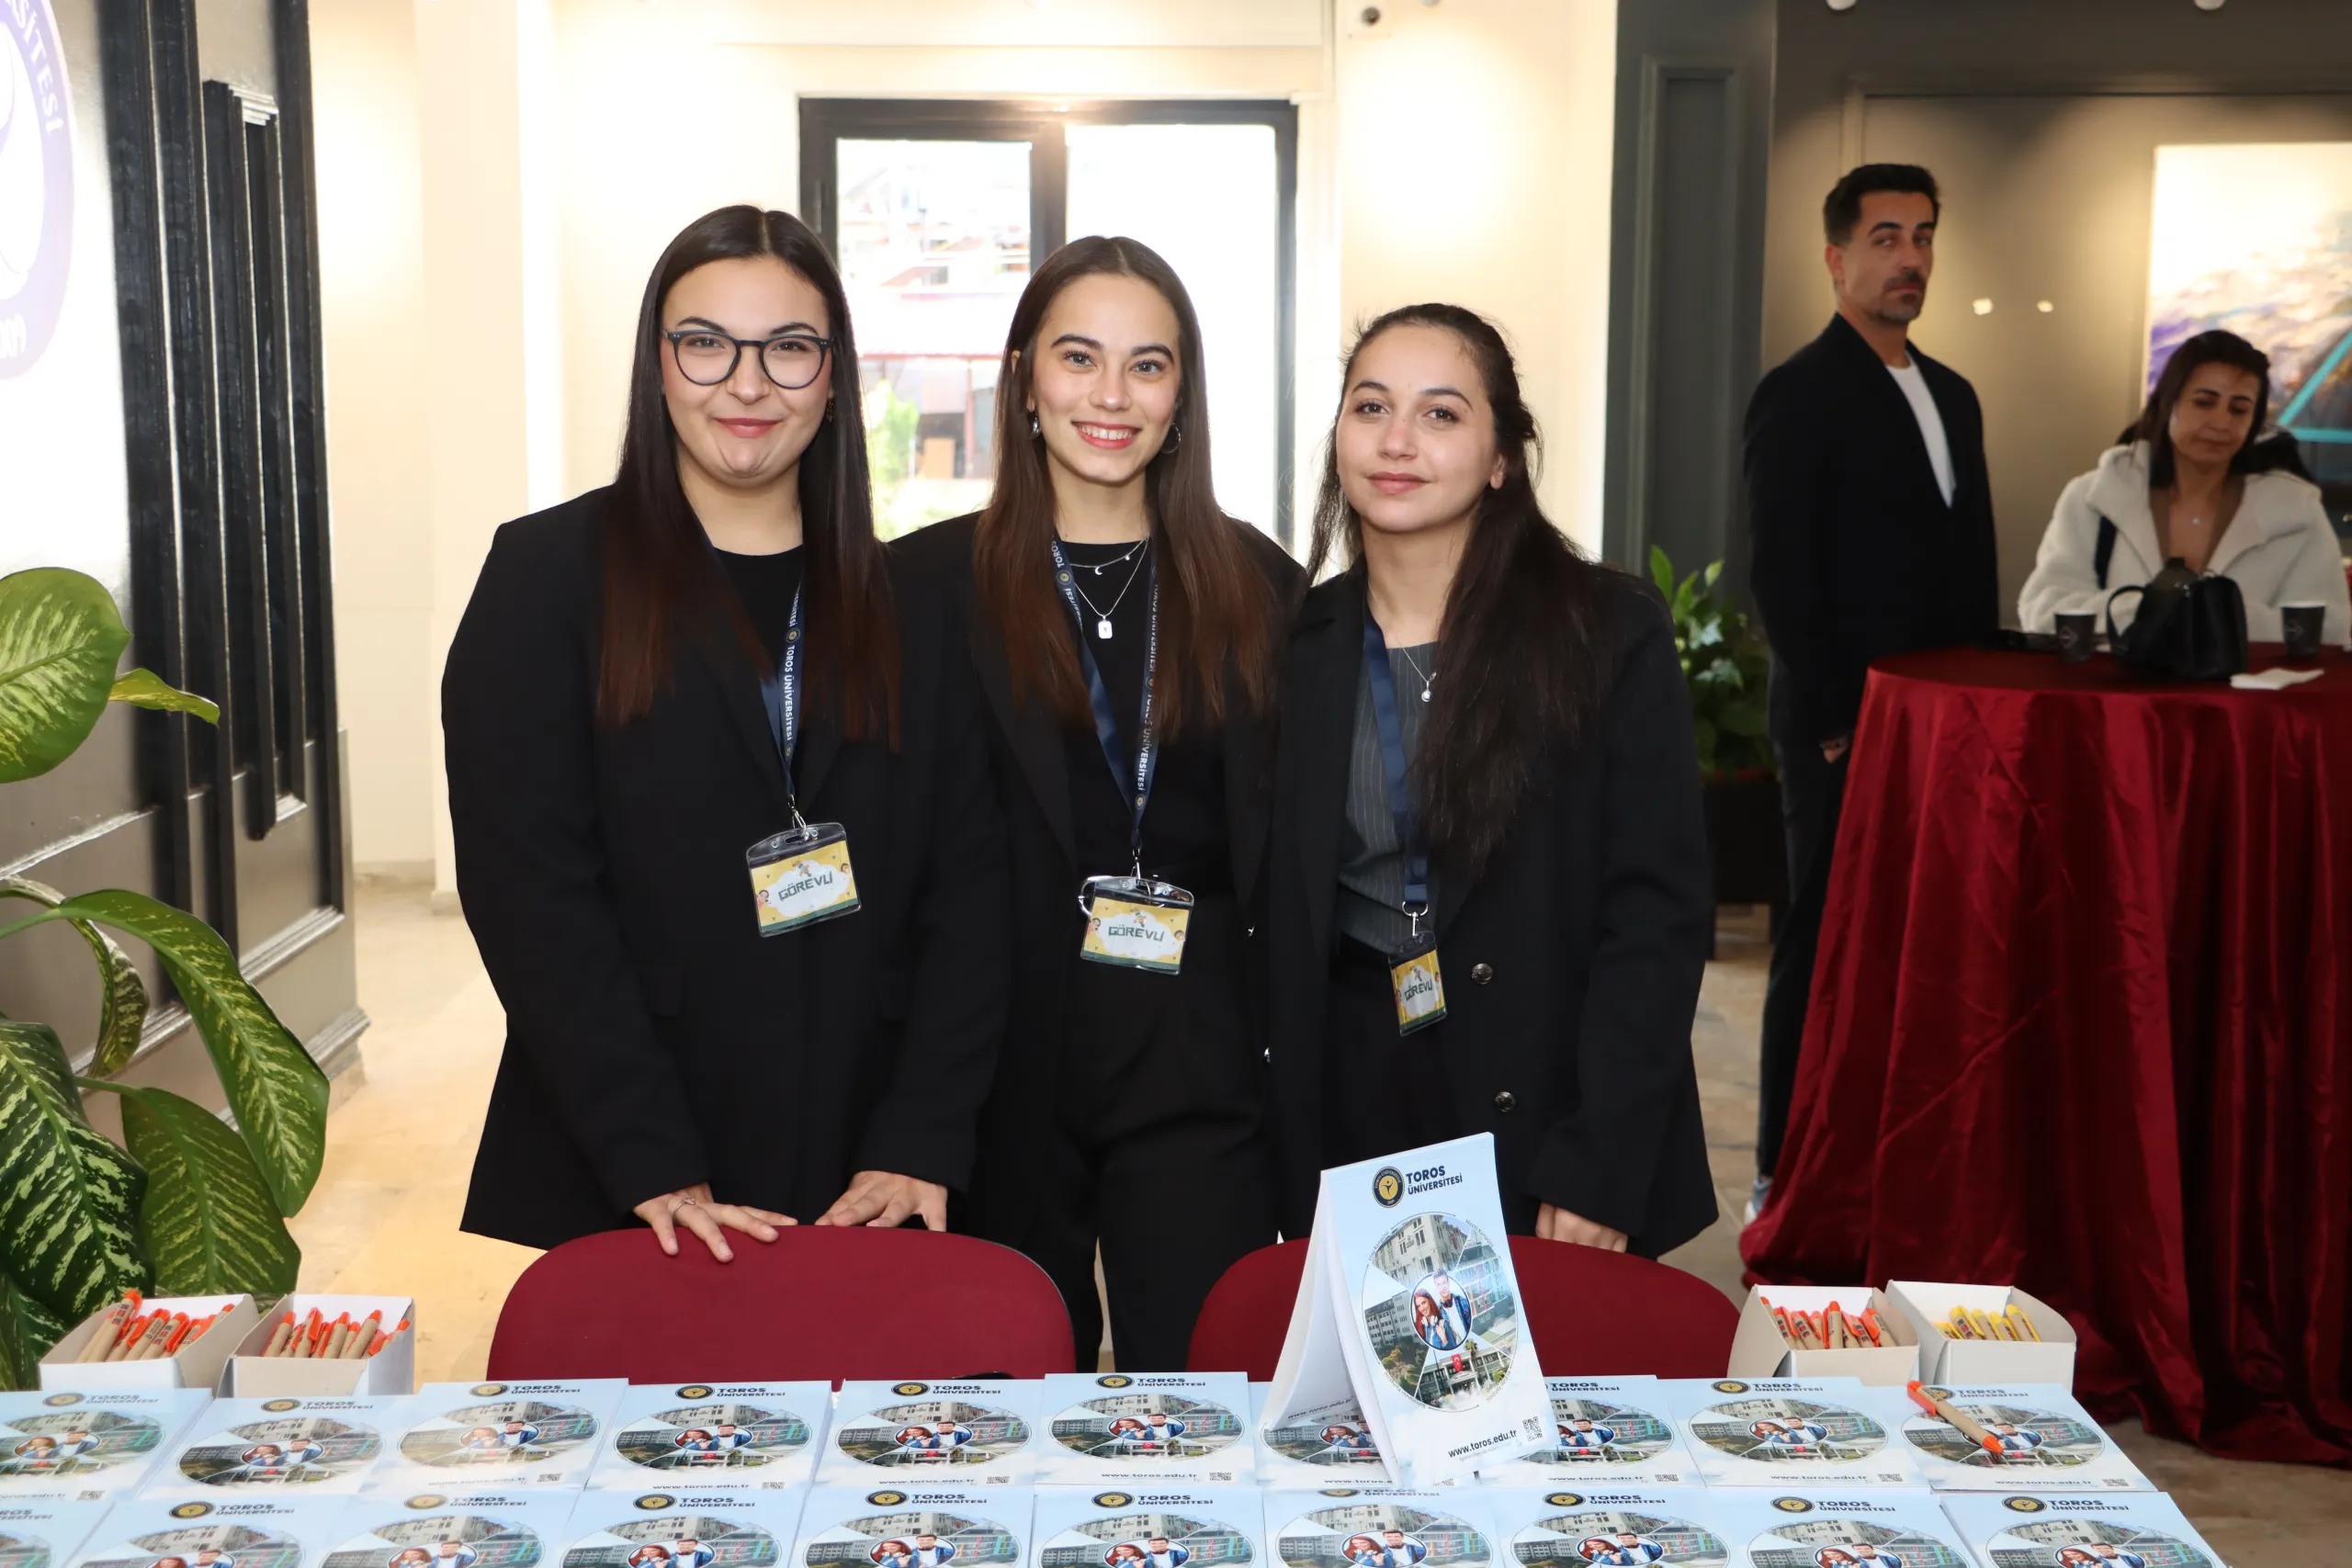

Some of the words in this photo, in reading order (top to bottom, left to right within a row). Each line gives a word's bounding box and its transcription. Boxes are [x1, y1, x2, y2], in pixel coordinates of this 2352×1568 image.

[785, 645, 796, 672] TOROS
[784, 674, 794, 741] ÜNİVERSİTESİ
[1406, 1165, 1446, 1184] TOROS
[1408, 1172, 1464, 1195] ÜNİVERSİTESİ
[1448, 1429, 1517, 1458] www.toros.edu.tr
